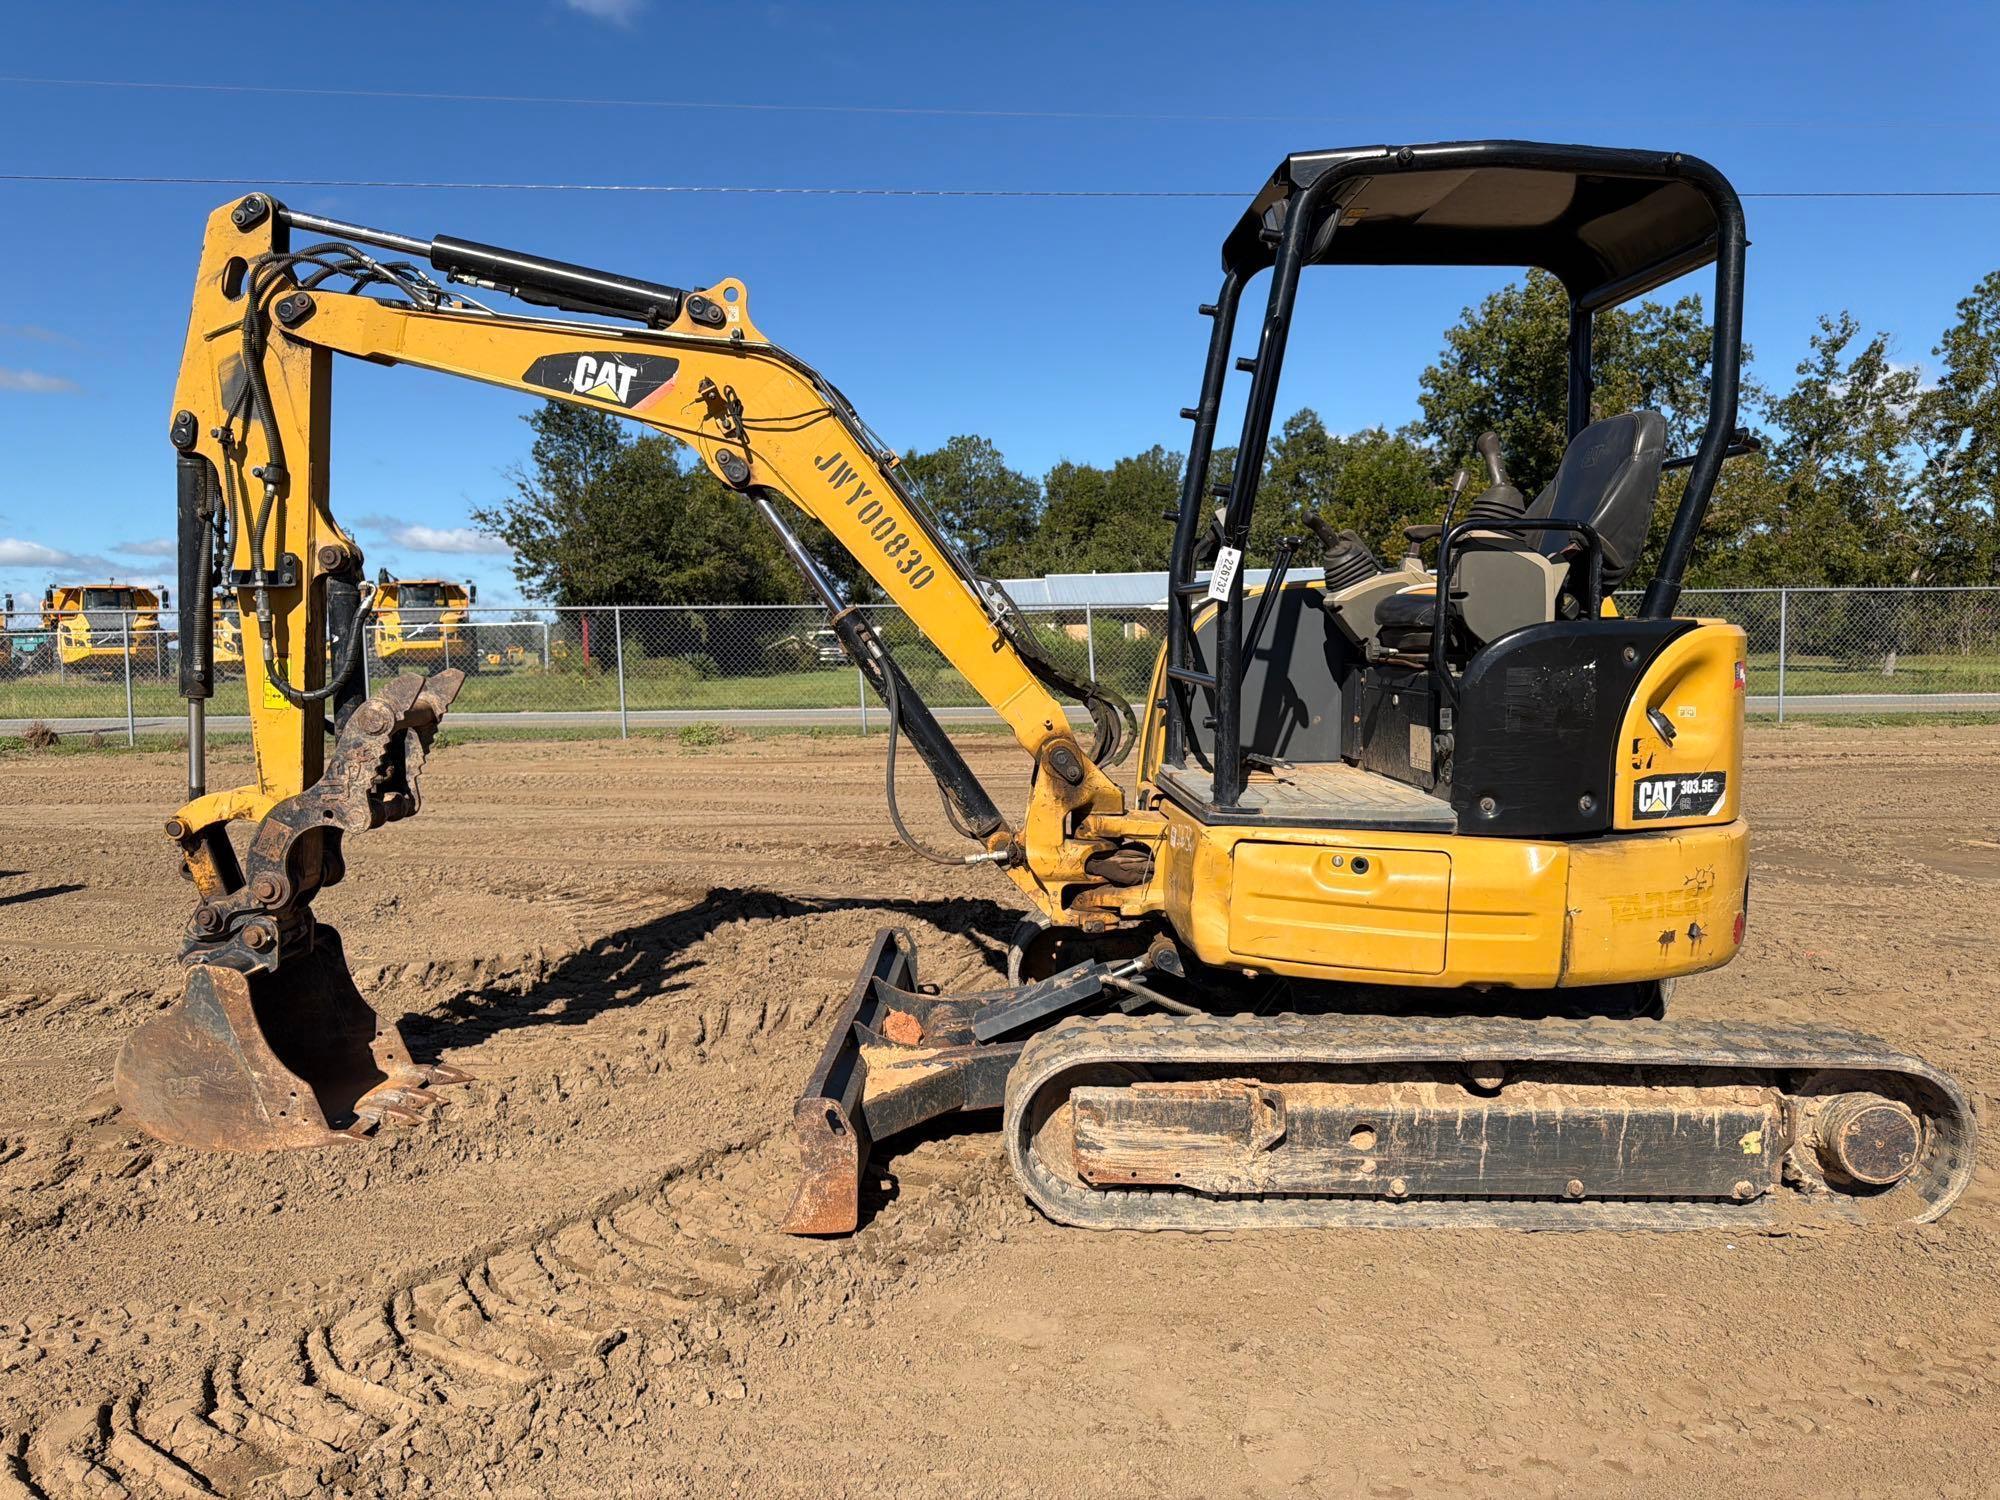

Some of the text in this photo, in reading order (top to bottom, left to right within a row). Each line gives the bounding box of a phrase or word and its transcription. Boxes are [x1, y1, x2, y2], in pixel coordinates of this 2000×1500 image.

[573, 355, 638, 404] CAT
[814, 451, 935, 590] JWY00830
[1215, 558, 1234, 593] 226732
[1638, 780, 1676, 813] CAT
